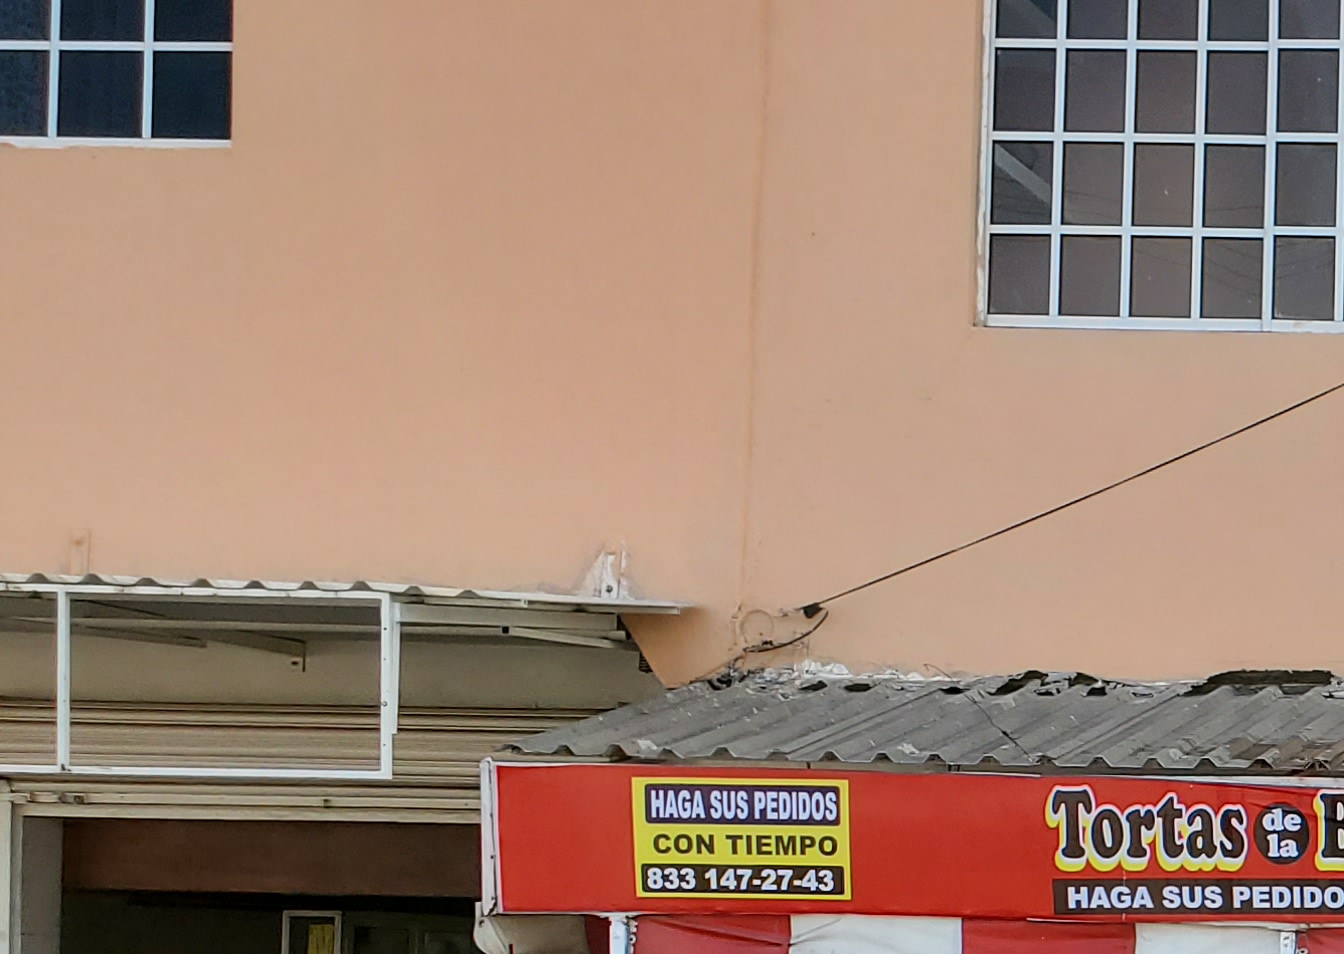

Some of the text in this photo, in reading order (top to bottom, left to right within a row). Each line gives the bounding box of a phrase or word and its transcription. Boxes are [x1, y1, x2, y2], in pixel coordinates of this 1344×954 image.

[650, 790, 838, 821] HAGA SUS PEDIDOS
[1044, 784, 1248, 872] Tortas
[1262, 808, 1301, 832] de
[653, 833, 838, 856] CON TIEMPO
[1267, 834, 1299, 858] la
[646, 867, 834, 891] 833 147-27-43
[1067, 886, 1154, 909] HAGA
[1162, 886, 1222, 909] SUS
